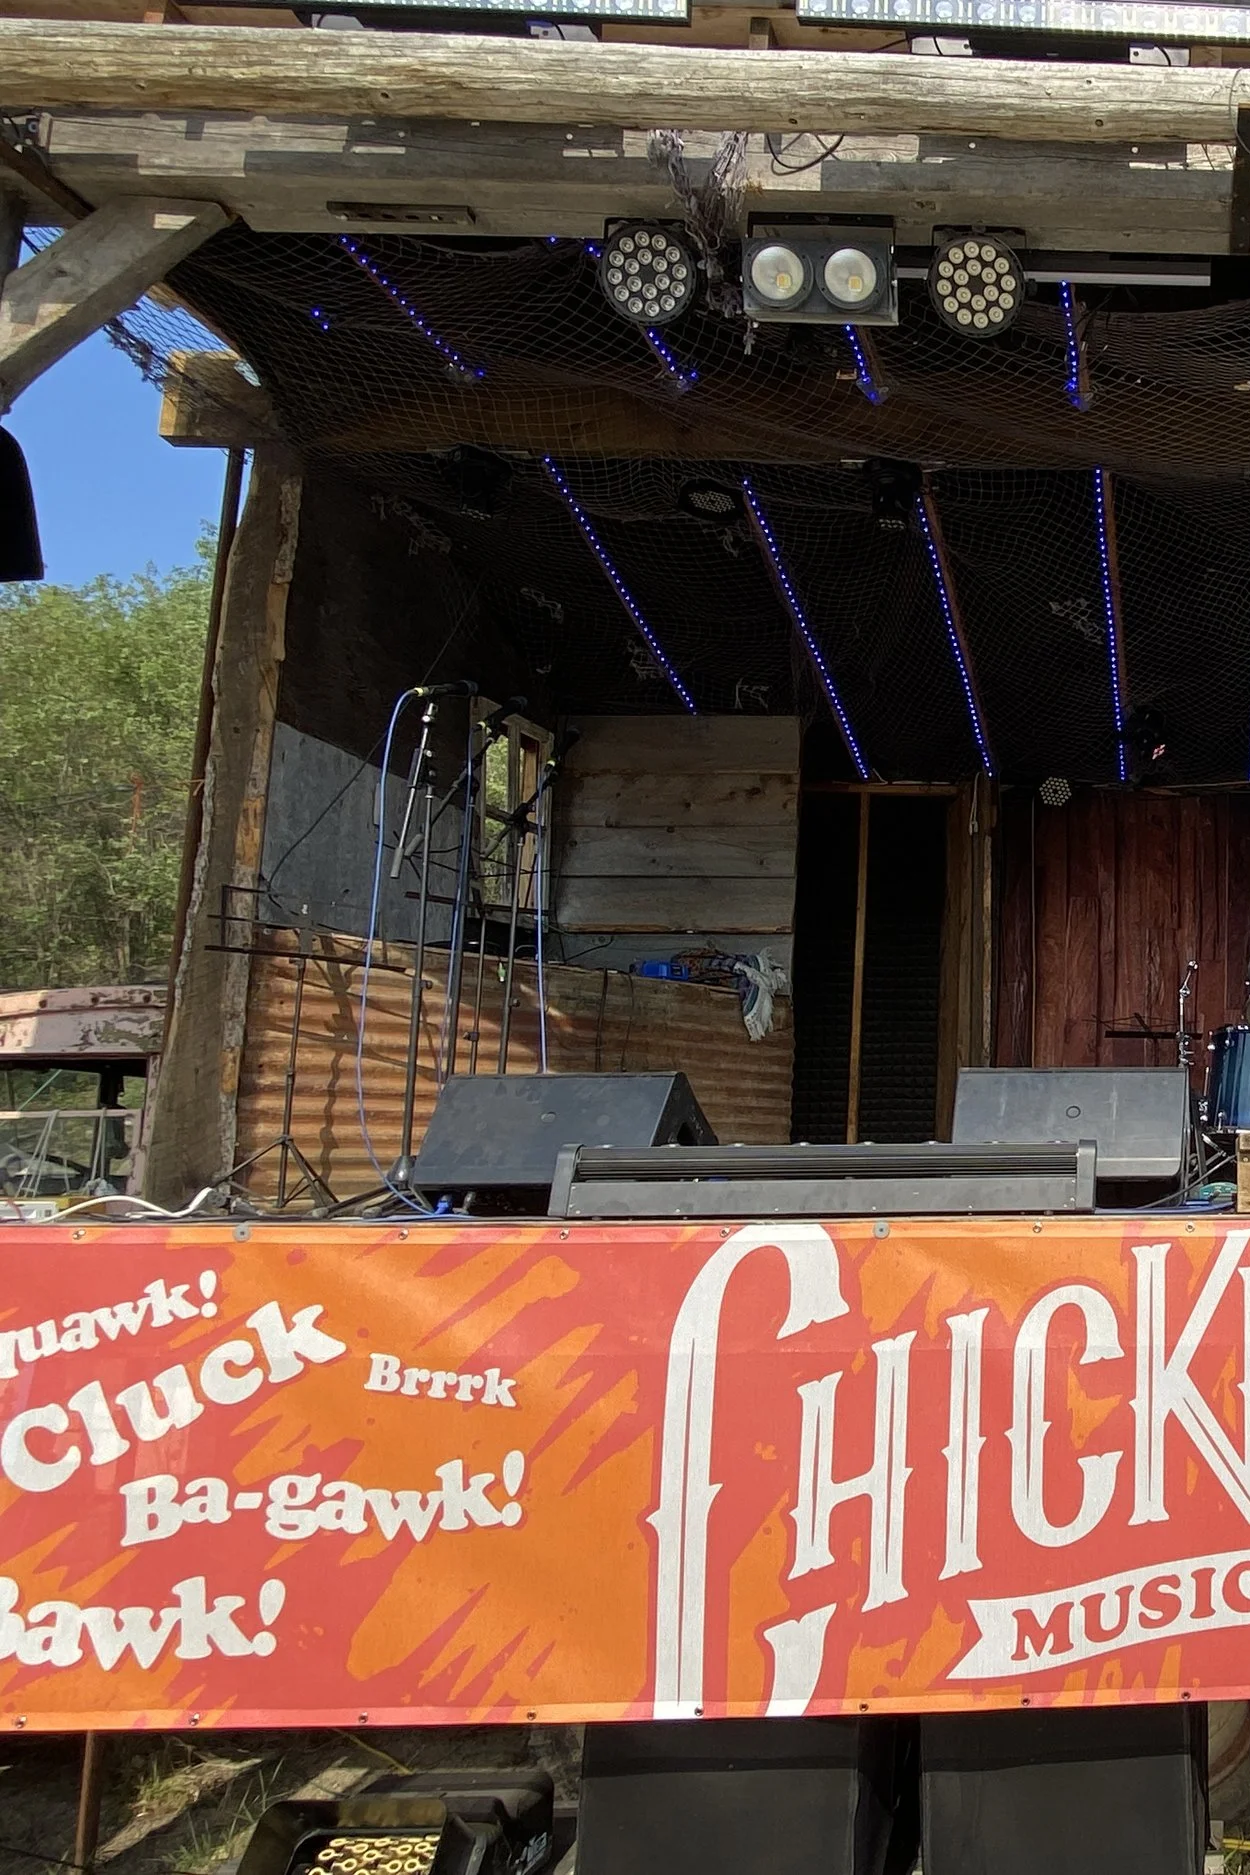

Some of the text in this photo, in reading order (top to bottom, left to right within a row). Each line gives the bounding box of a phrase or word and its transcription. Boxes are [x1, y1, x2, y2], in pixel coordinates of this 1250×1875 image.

[0, 1301, 346, 1493] Cluck
[364, 1353, 517, 1407] Brrrk
[119, 1450, 525, 1547] Ba-gawk!
